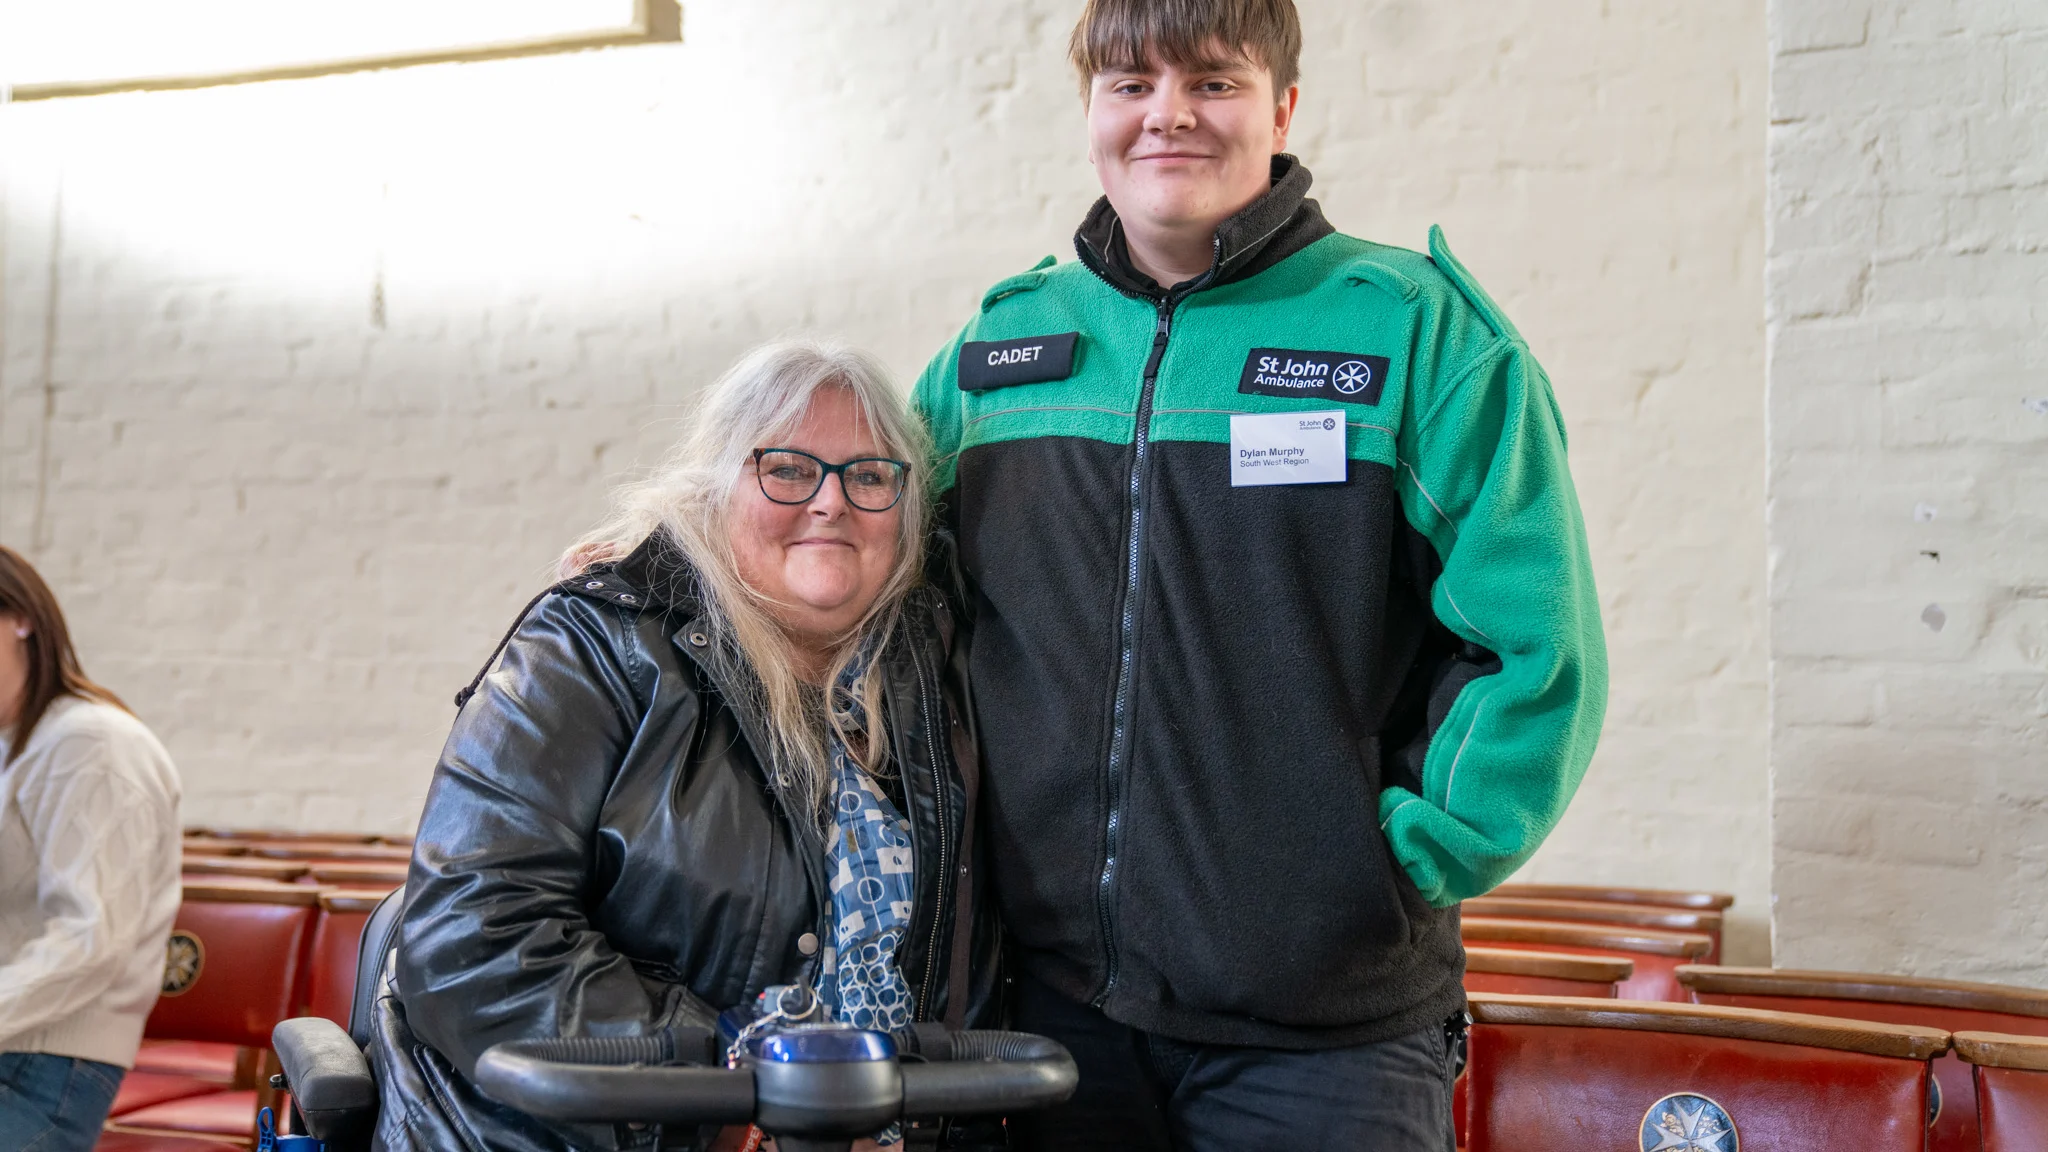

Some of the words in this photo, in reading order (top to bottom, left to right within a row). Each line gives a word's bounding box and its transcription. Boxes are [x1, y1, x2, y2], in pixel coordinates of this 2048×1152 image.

[987, 345, 1043, 366] CADET
[1257, 356, 1280, 374] St
[1281, 358, 1329, 377] John
[1253, 373, 1325, 389] Ambulance
[1240, 449, 1267, 459] Dylan
[1269, 447, 1305, 457] Murphy
[1240, 460, 1261, 468] South
[1283, 457, 1309, 466] Region
